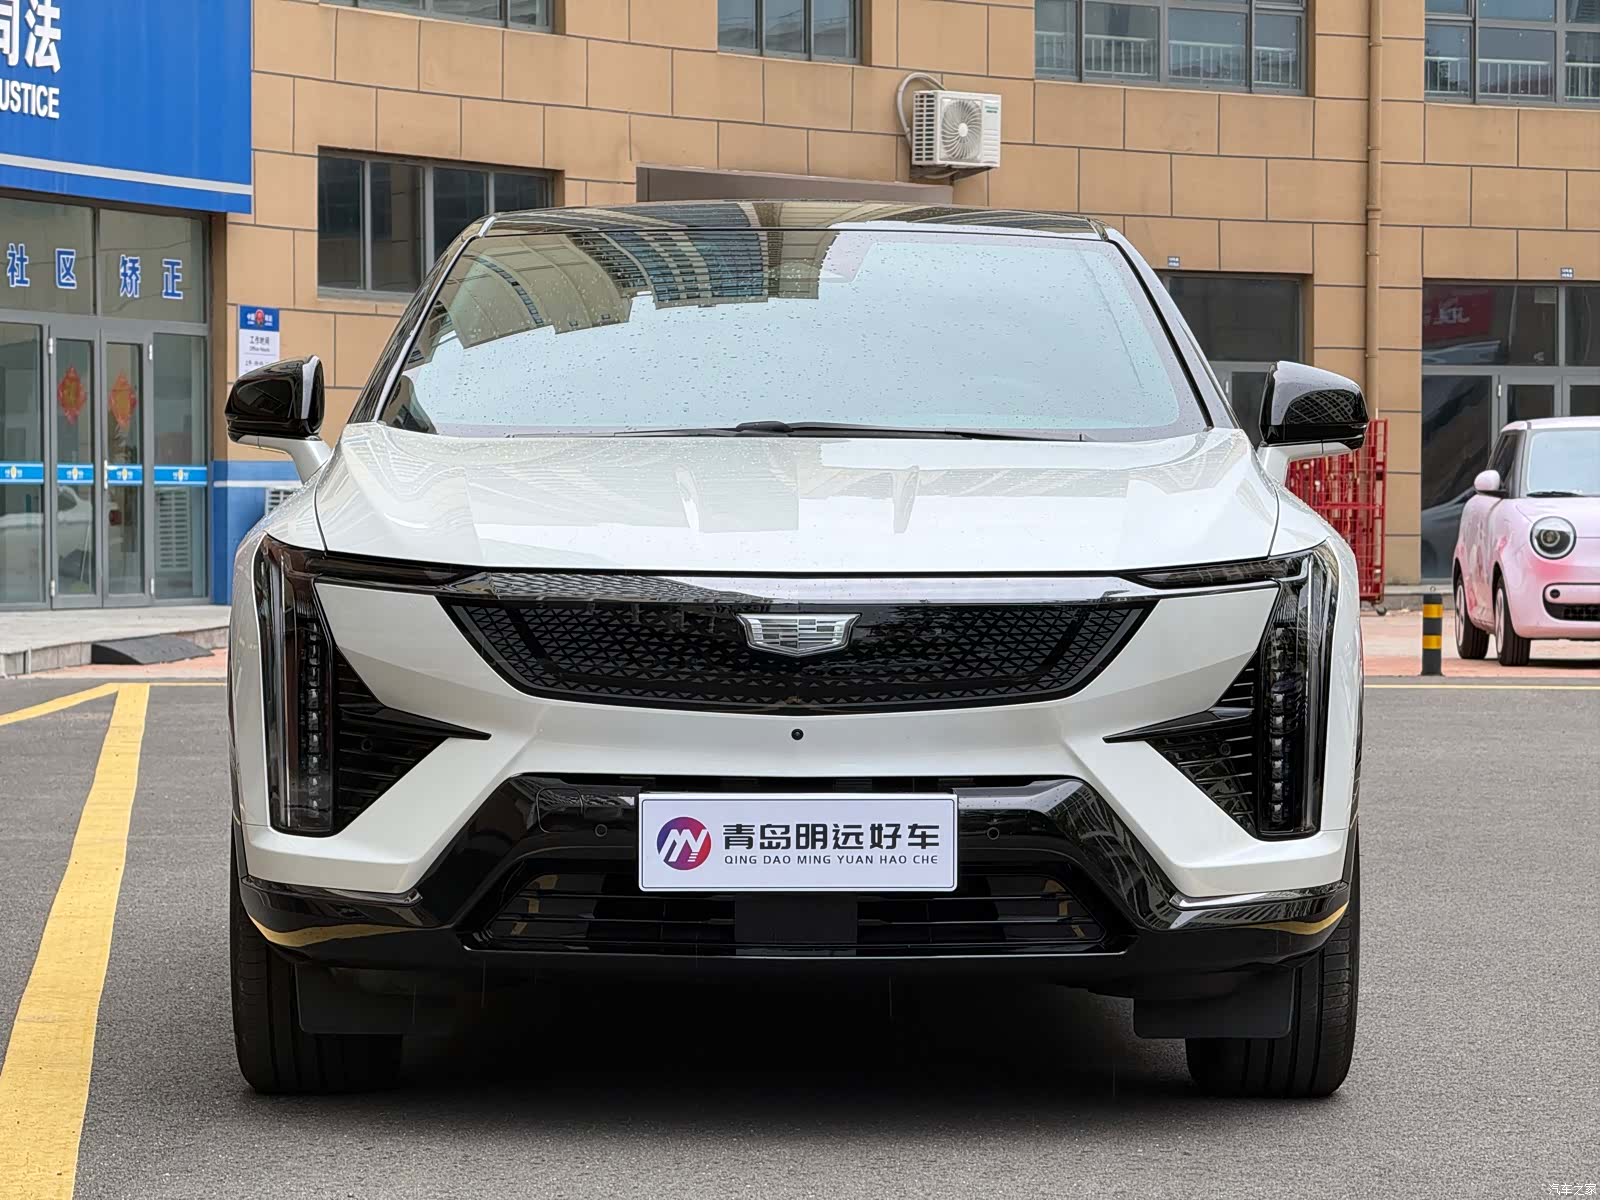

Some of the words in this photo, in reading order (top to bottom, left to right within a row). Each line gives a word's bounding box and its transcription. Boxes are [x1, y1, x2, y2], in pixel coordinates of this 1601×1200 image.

[7, 243, 184, 299] 社区矫正
[723, 823, 940, 850] 青岛明远好车
[724, 855, 757, 865] QING
[763, 855, 792, 864] DAO
[797, 855, 831, 864] MING
[837, 855, 873, 864] YUAN
[880, 855, 907, 864] HAO
[913, 855, 938, 864] CHE
